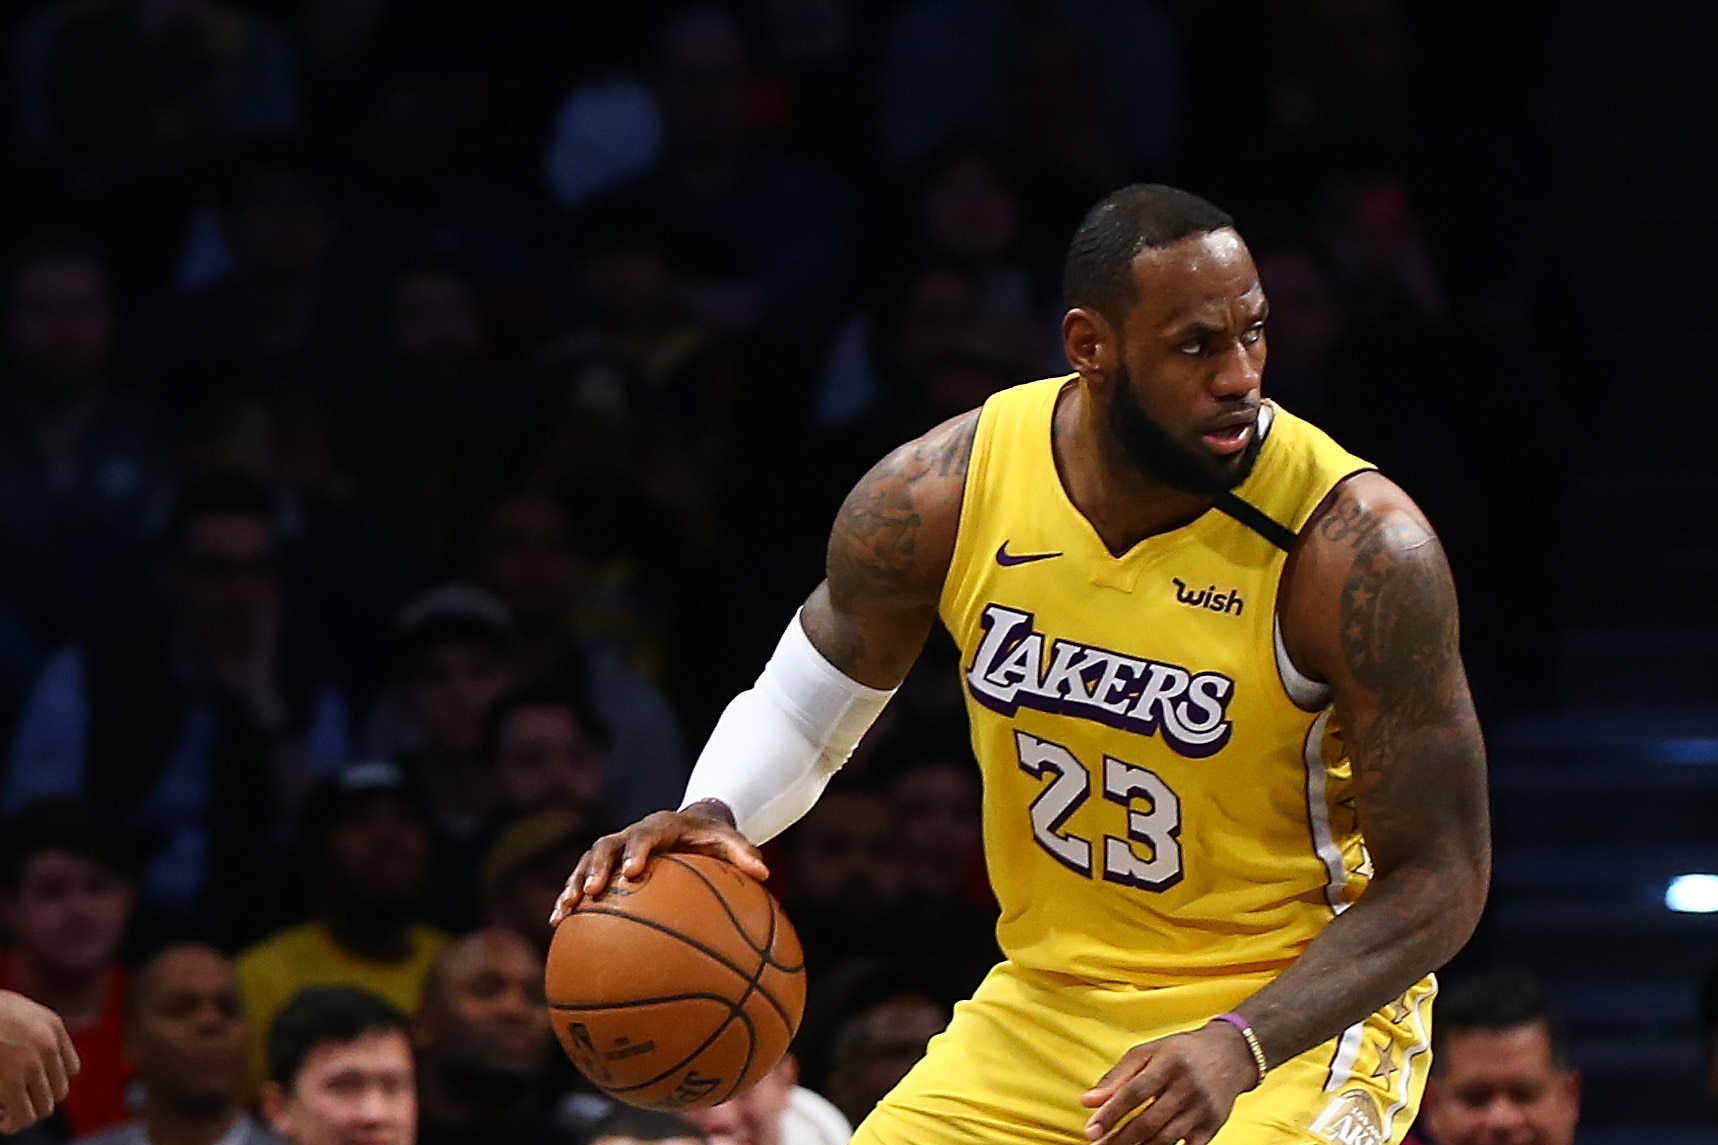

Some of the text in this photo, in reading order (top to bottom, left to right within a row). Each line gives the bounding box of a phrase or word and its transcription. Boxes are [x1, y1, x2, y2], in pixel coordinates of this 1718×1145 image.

[1172, 577, 1243, 616] wish
[967, 604, 1234, 757] LAKERS
[1014, 729, 1184, 893] 23
